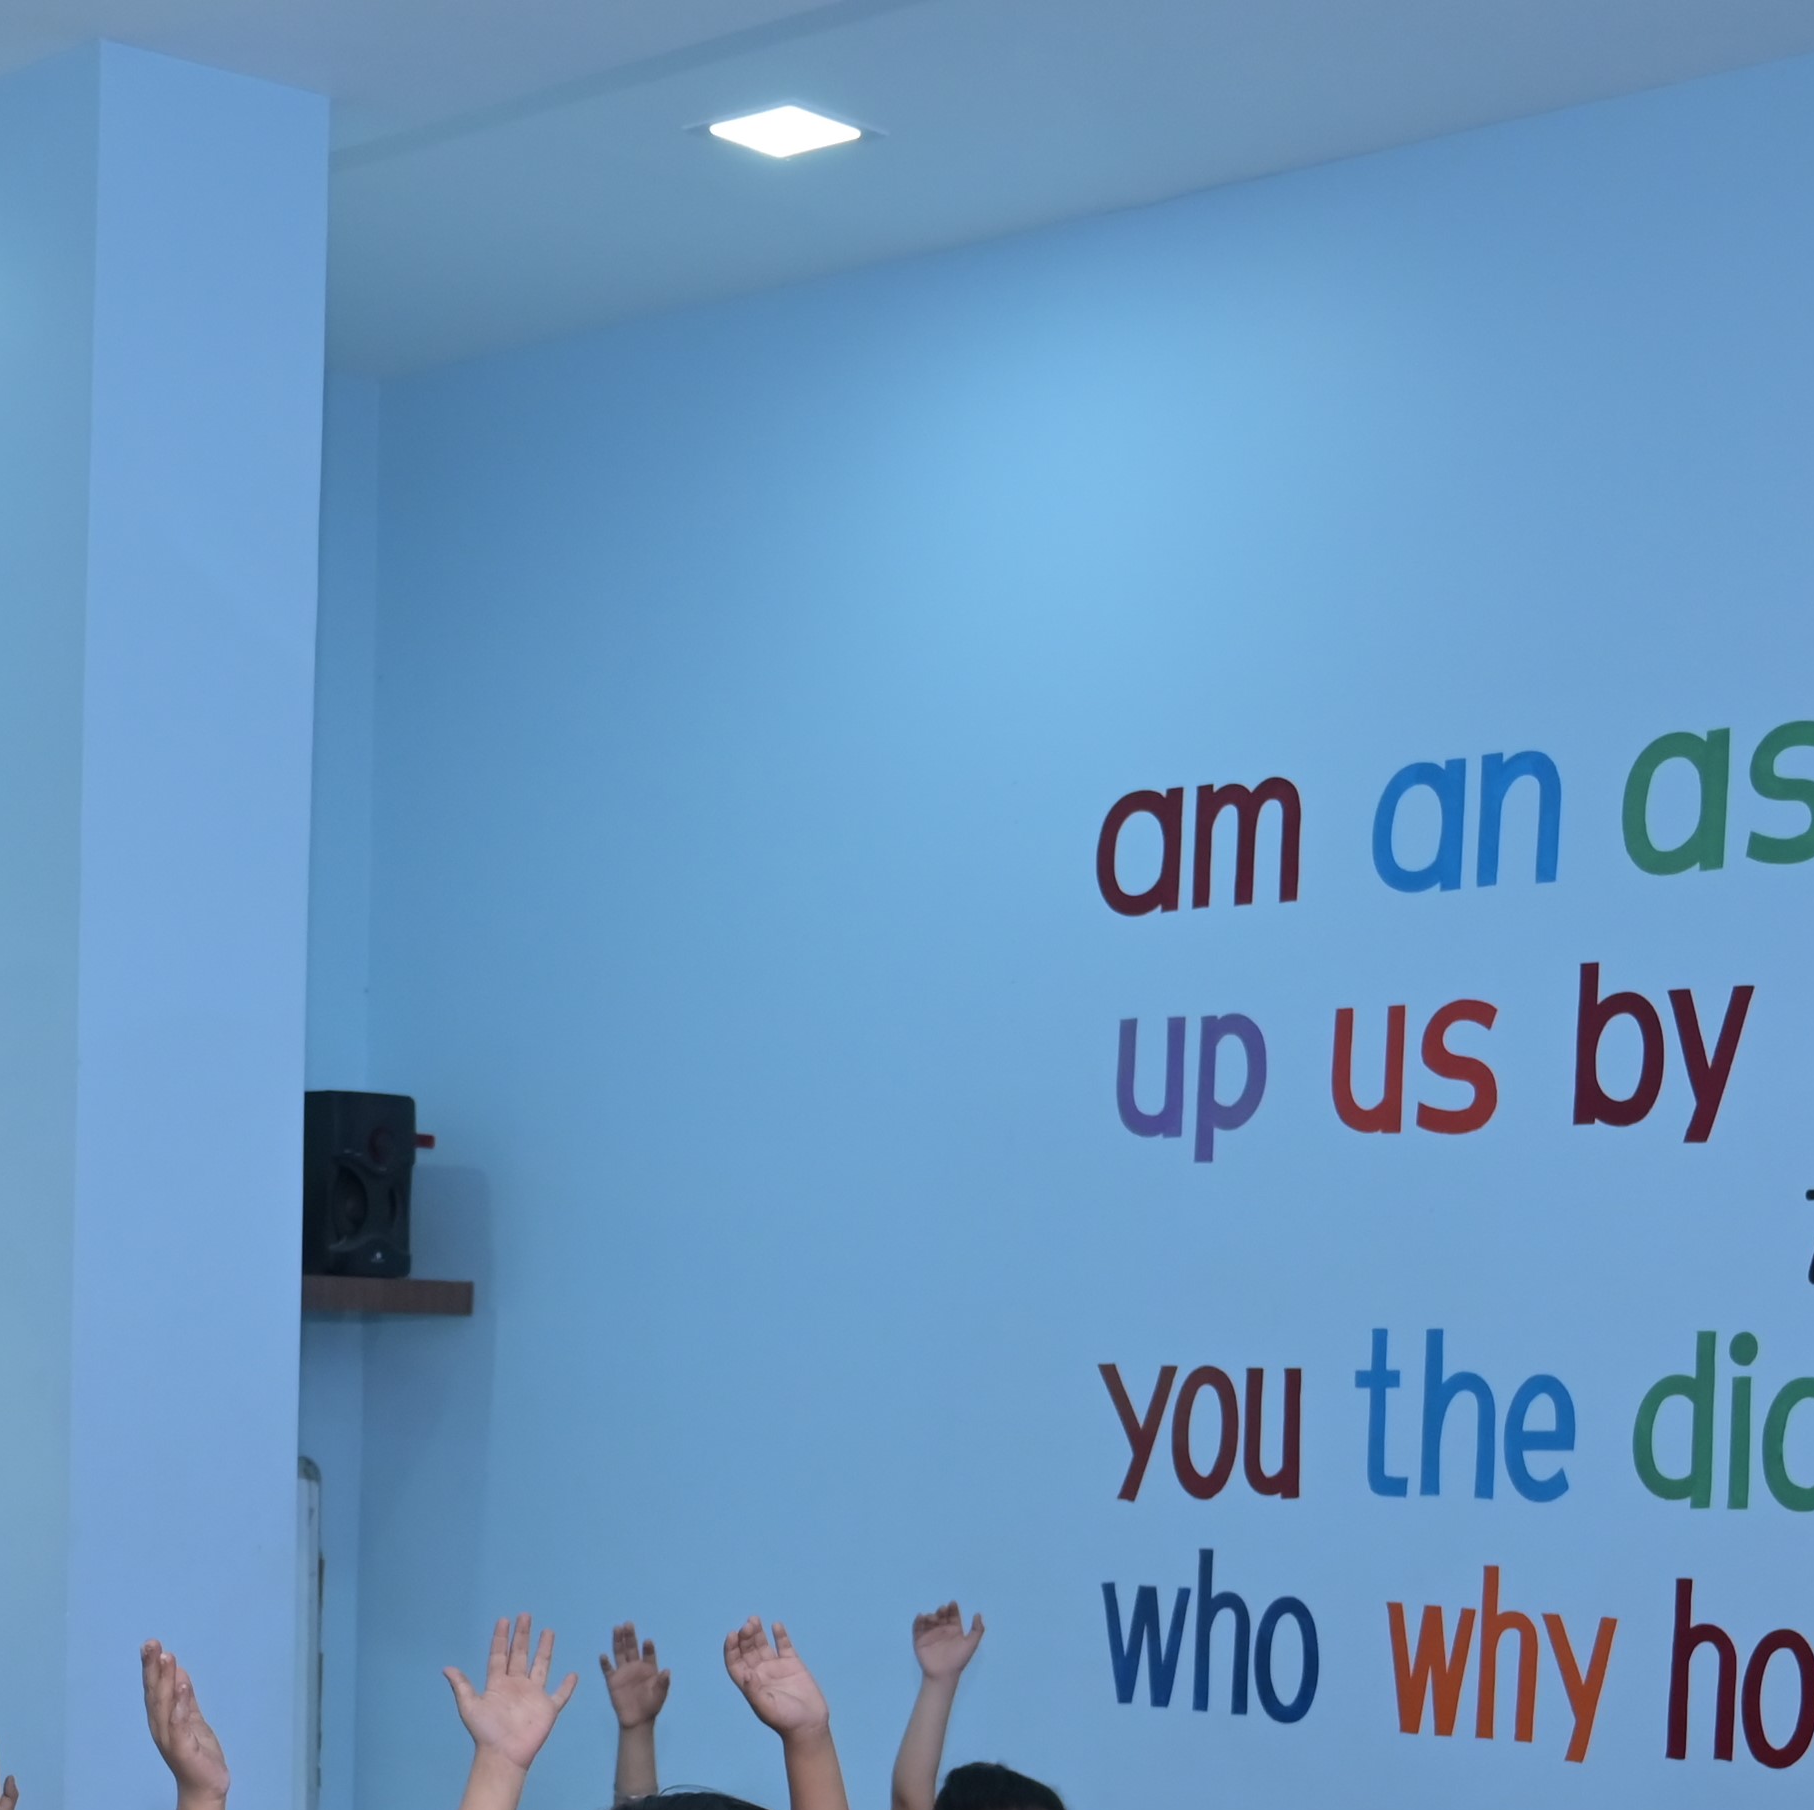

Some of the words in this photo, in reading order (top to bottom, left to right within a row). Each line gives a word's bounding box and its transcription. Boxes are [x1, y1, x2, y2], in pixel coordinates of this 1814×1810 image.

[1097, 776, 1301, 916] am
[1373, 752, 1563, 892] an
[1117, 1012, 1267, 1164] up
[1331, 998, 1499, 1136] us
[1573, 962, 1755, 1144] by
[1097, 1364, 1301, 1503] you
[1355, 1328, 1576, 1503] the
[1101, 1548, 1321, 1724] who
[1387, 1566, 1617, 1763] why
